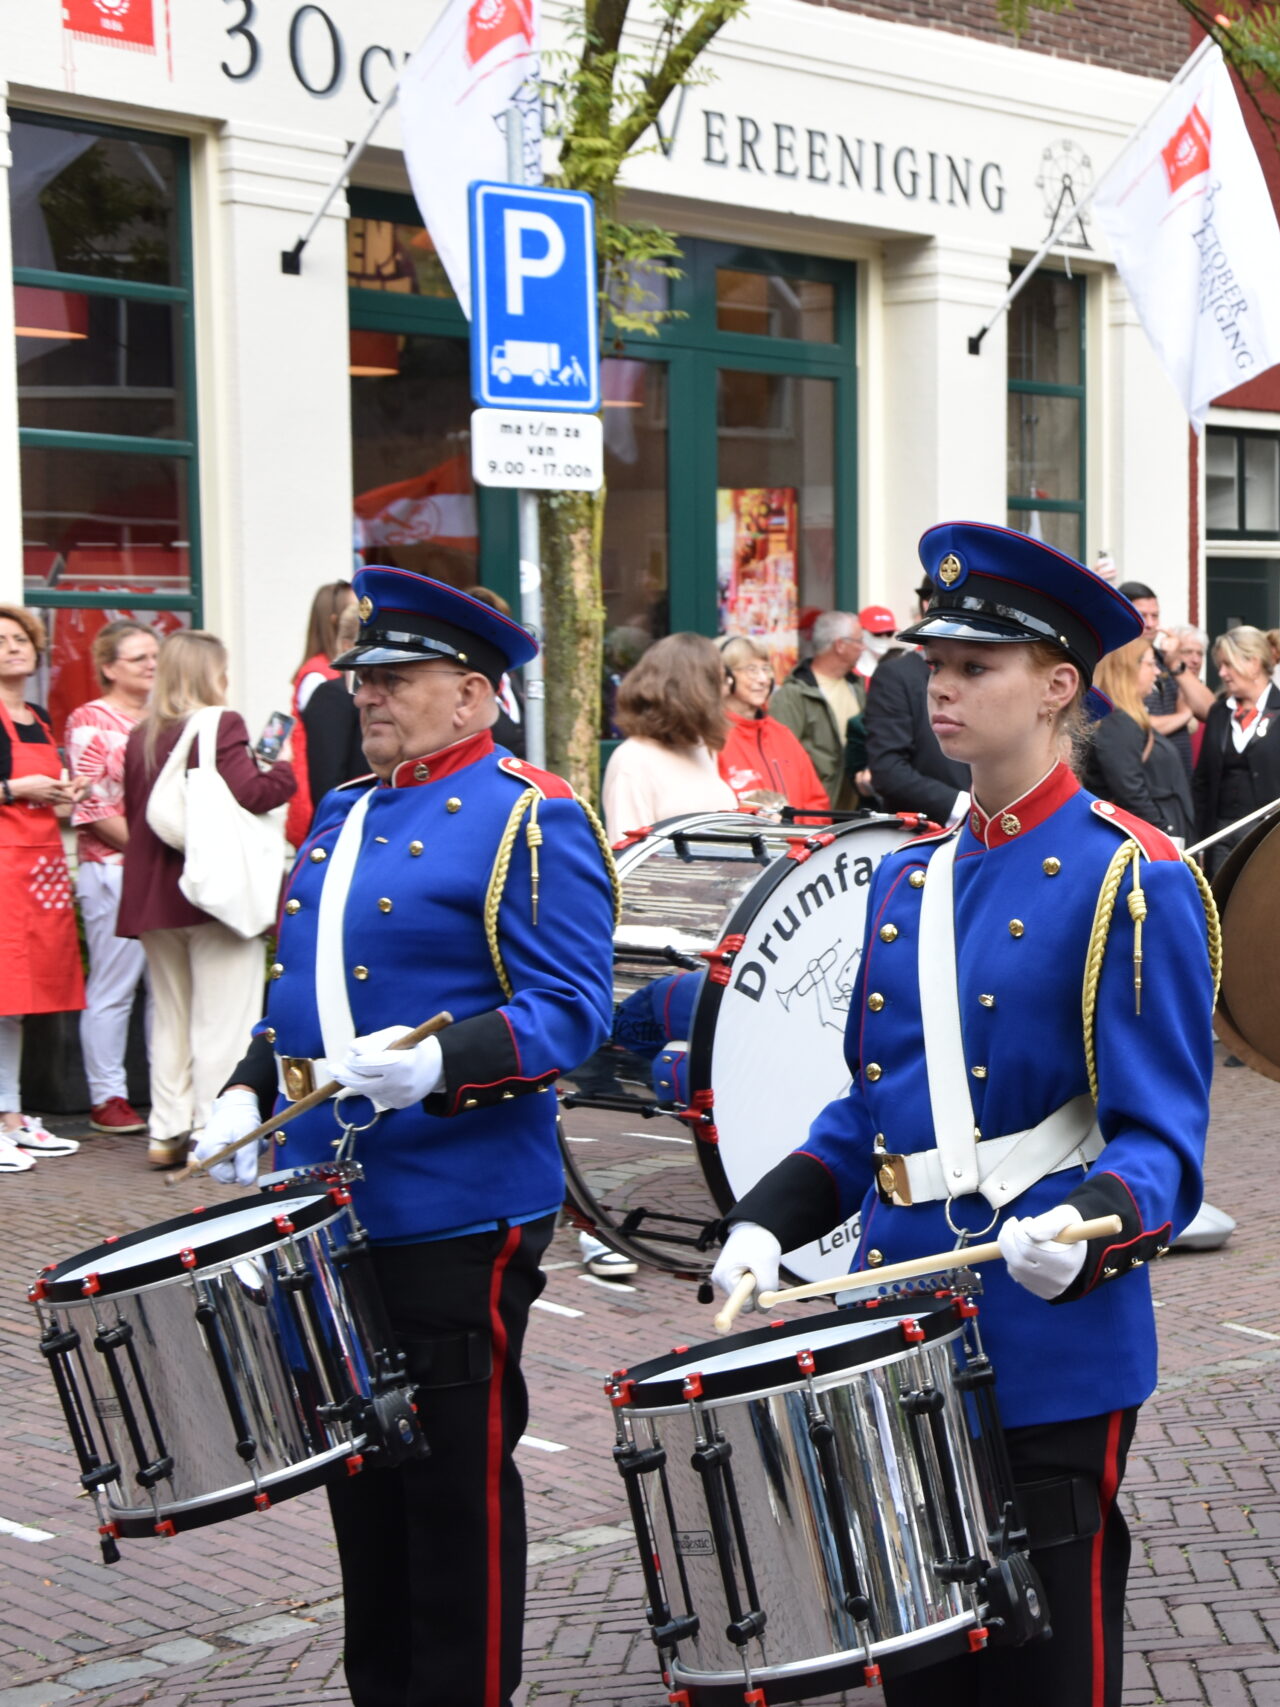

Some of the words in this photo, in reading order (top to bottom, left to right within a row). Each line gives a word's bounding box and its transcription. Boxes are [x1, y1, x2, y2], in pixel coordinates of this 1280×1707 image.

[503, 209, 565, 315] P
[500, 423, 522, 435] ma
[528, 421, 558, 437] t/m
[564, 427, 580, 438] za
[527, 445, 555, 456] van
[488, 460, 524, 475] 9.00
[543, 462, 593, 478] 17.00h
[734, 852, 885, 1003] Drumfa
